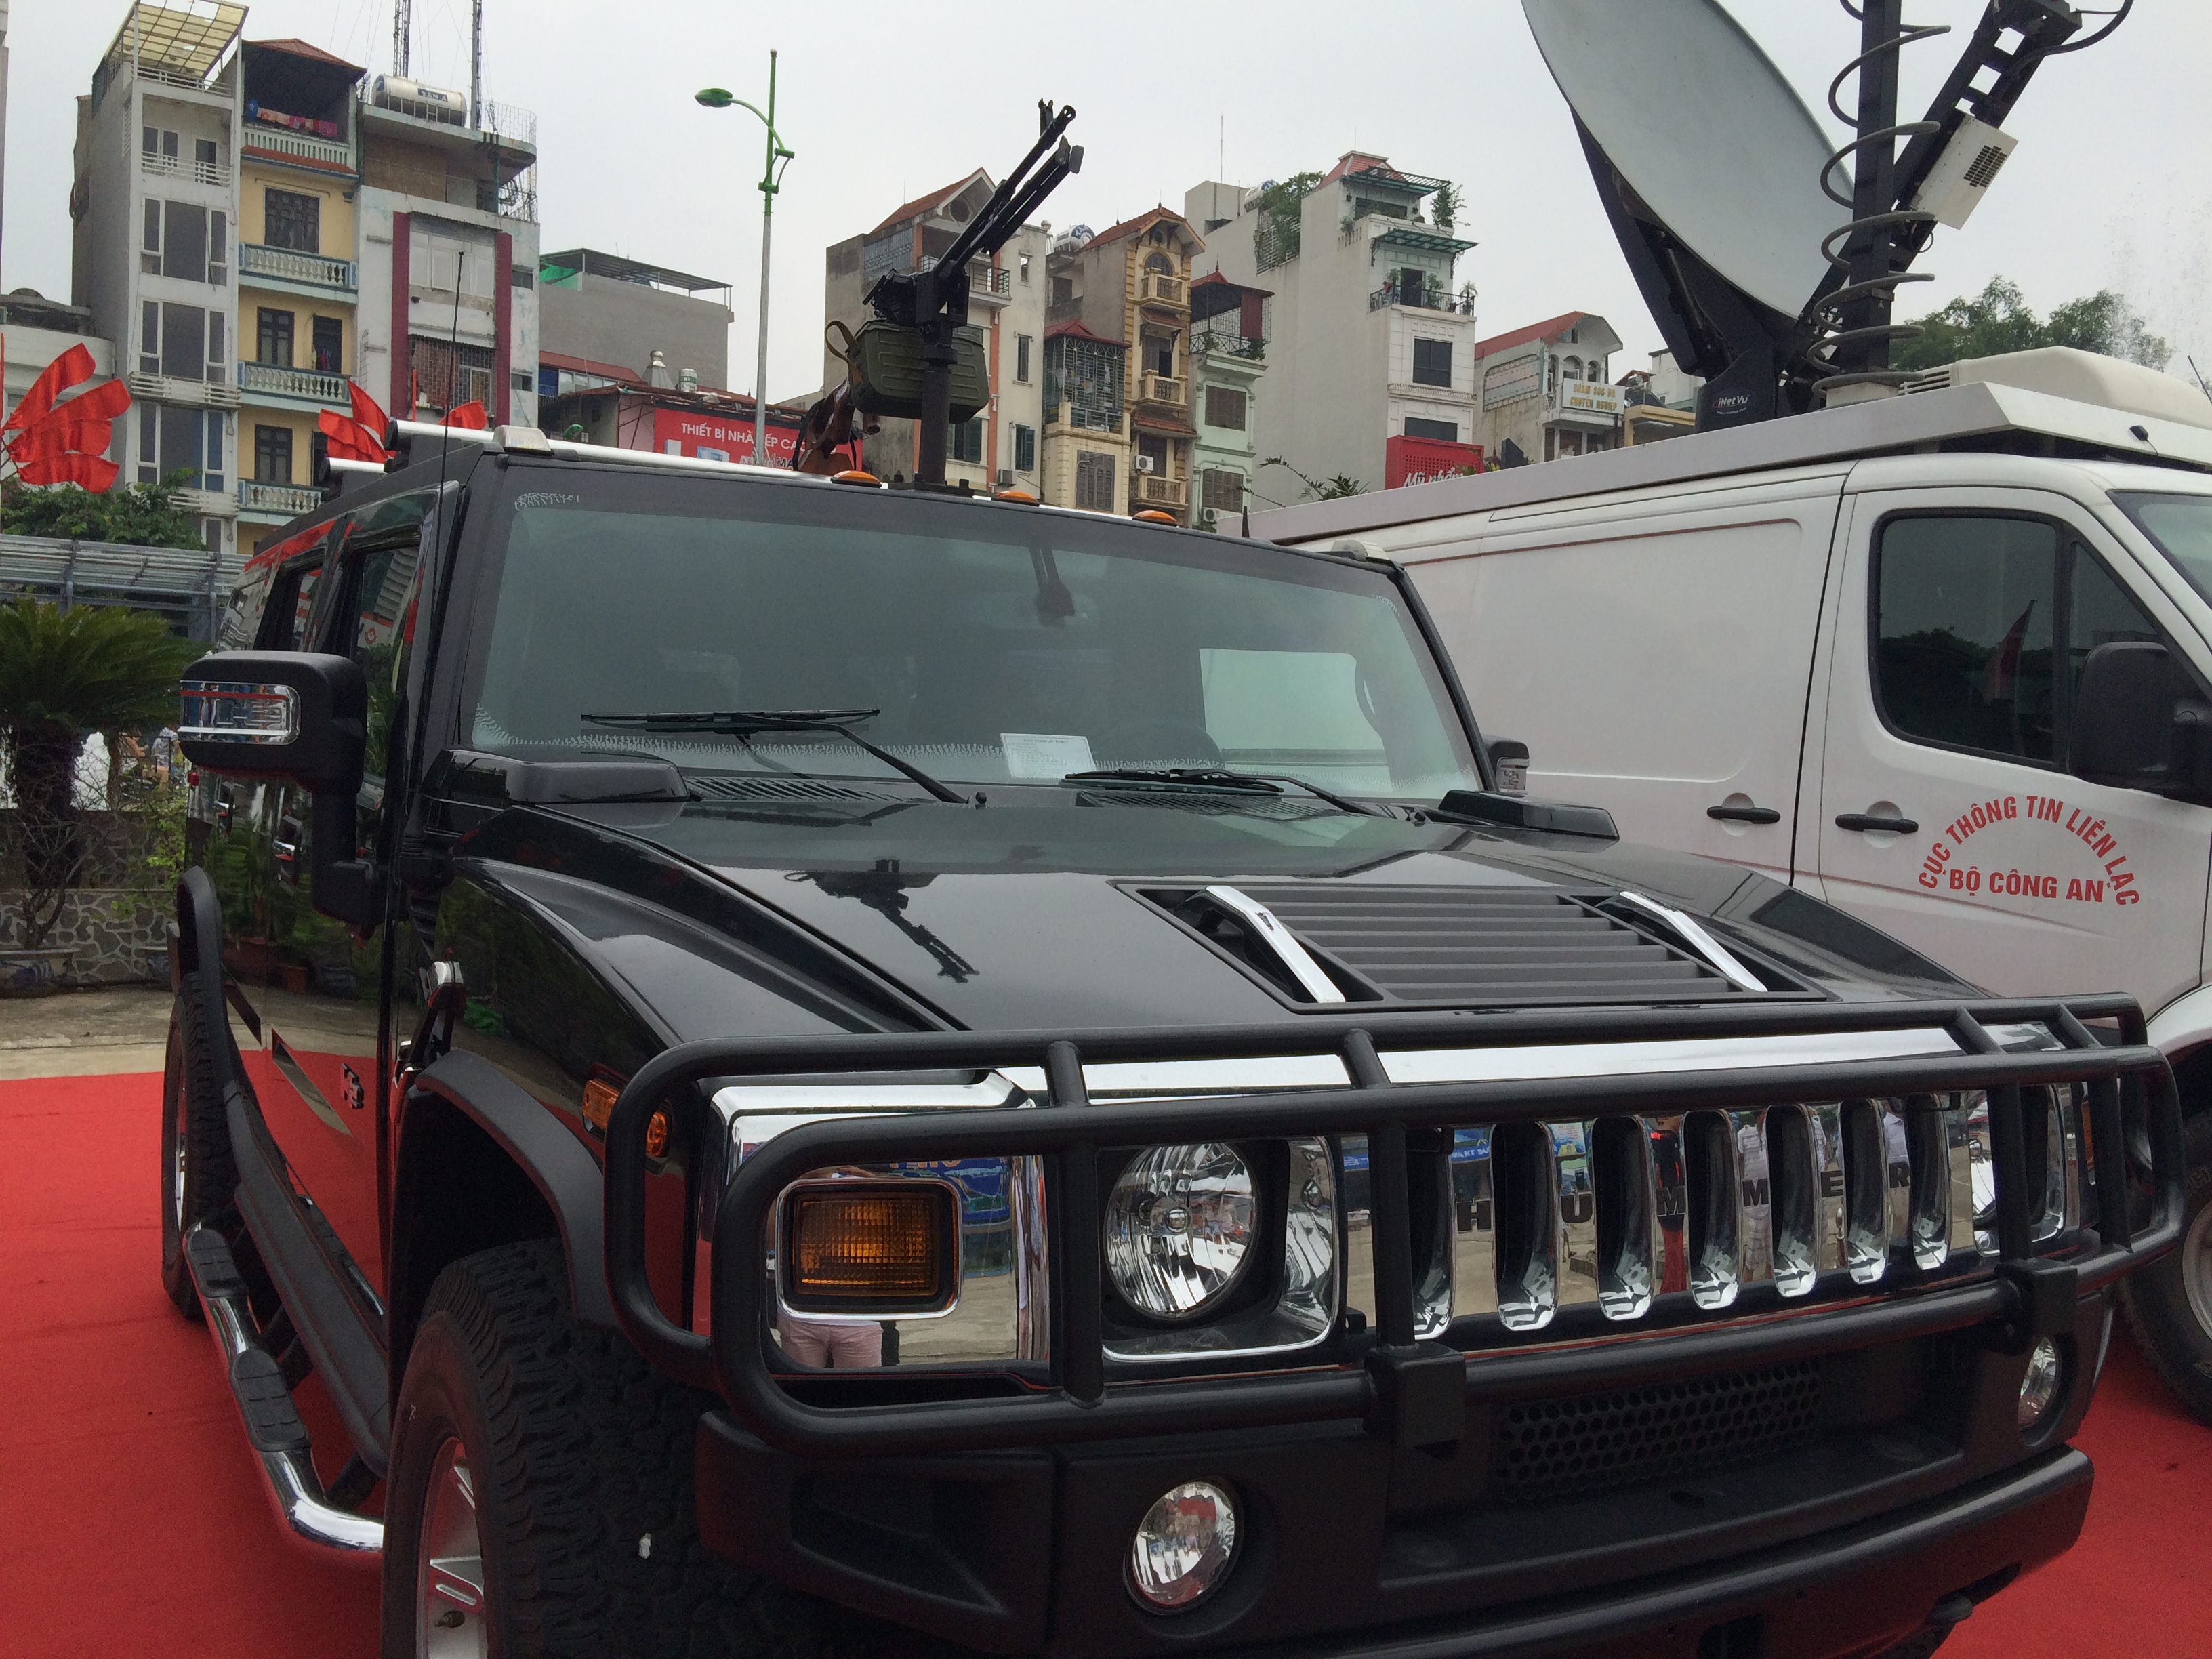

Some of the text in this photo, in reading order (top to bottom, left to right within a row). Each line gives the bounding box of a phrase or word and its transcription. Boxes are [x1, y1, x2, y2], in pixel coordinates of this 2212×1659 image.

[1717, 395, 1748, 407] iNetVu
[681, 422, 712, 438] THIẾT
[714, 426, 726, 442] BỊ
[728, 430, 754, 445] NHÀ
[764, 432, 779, 447] ẾP
[1918, 795, 2140, 906] CỤC THÔNG TIN LIÊN LẠC
[1950, 865, 2104, 903] BỘ CÔNG AN
[1456, 1162, 1910, 1233] HUMMER
